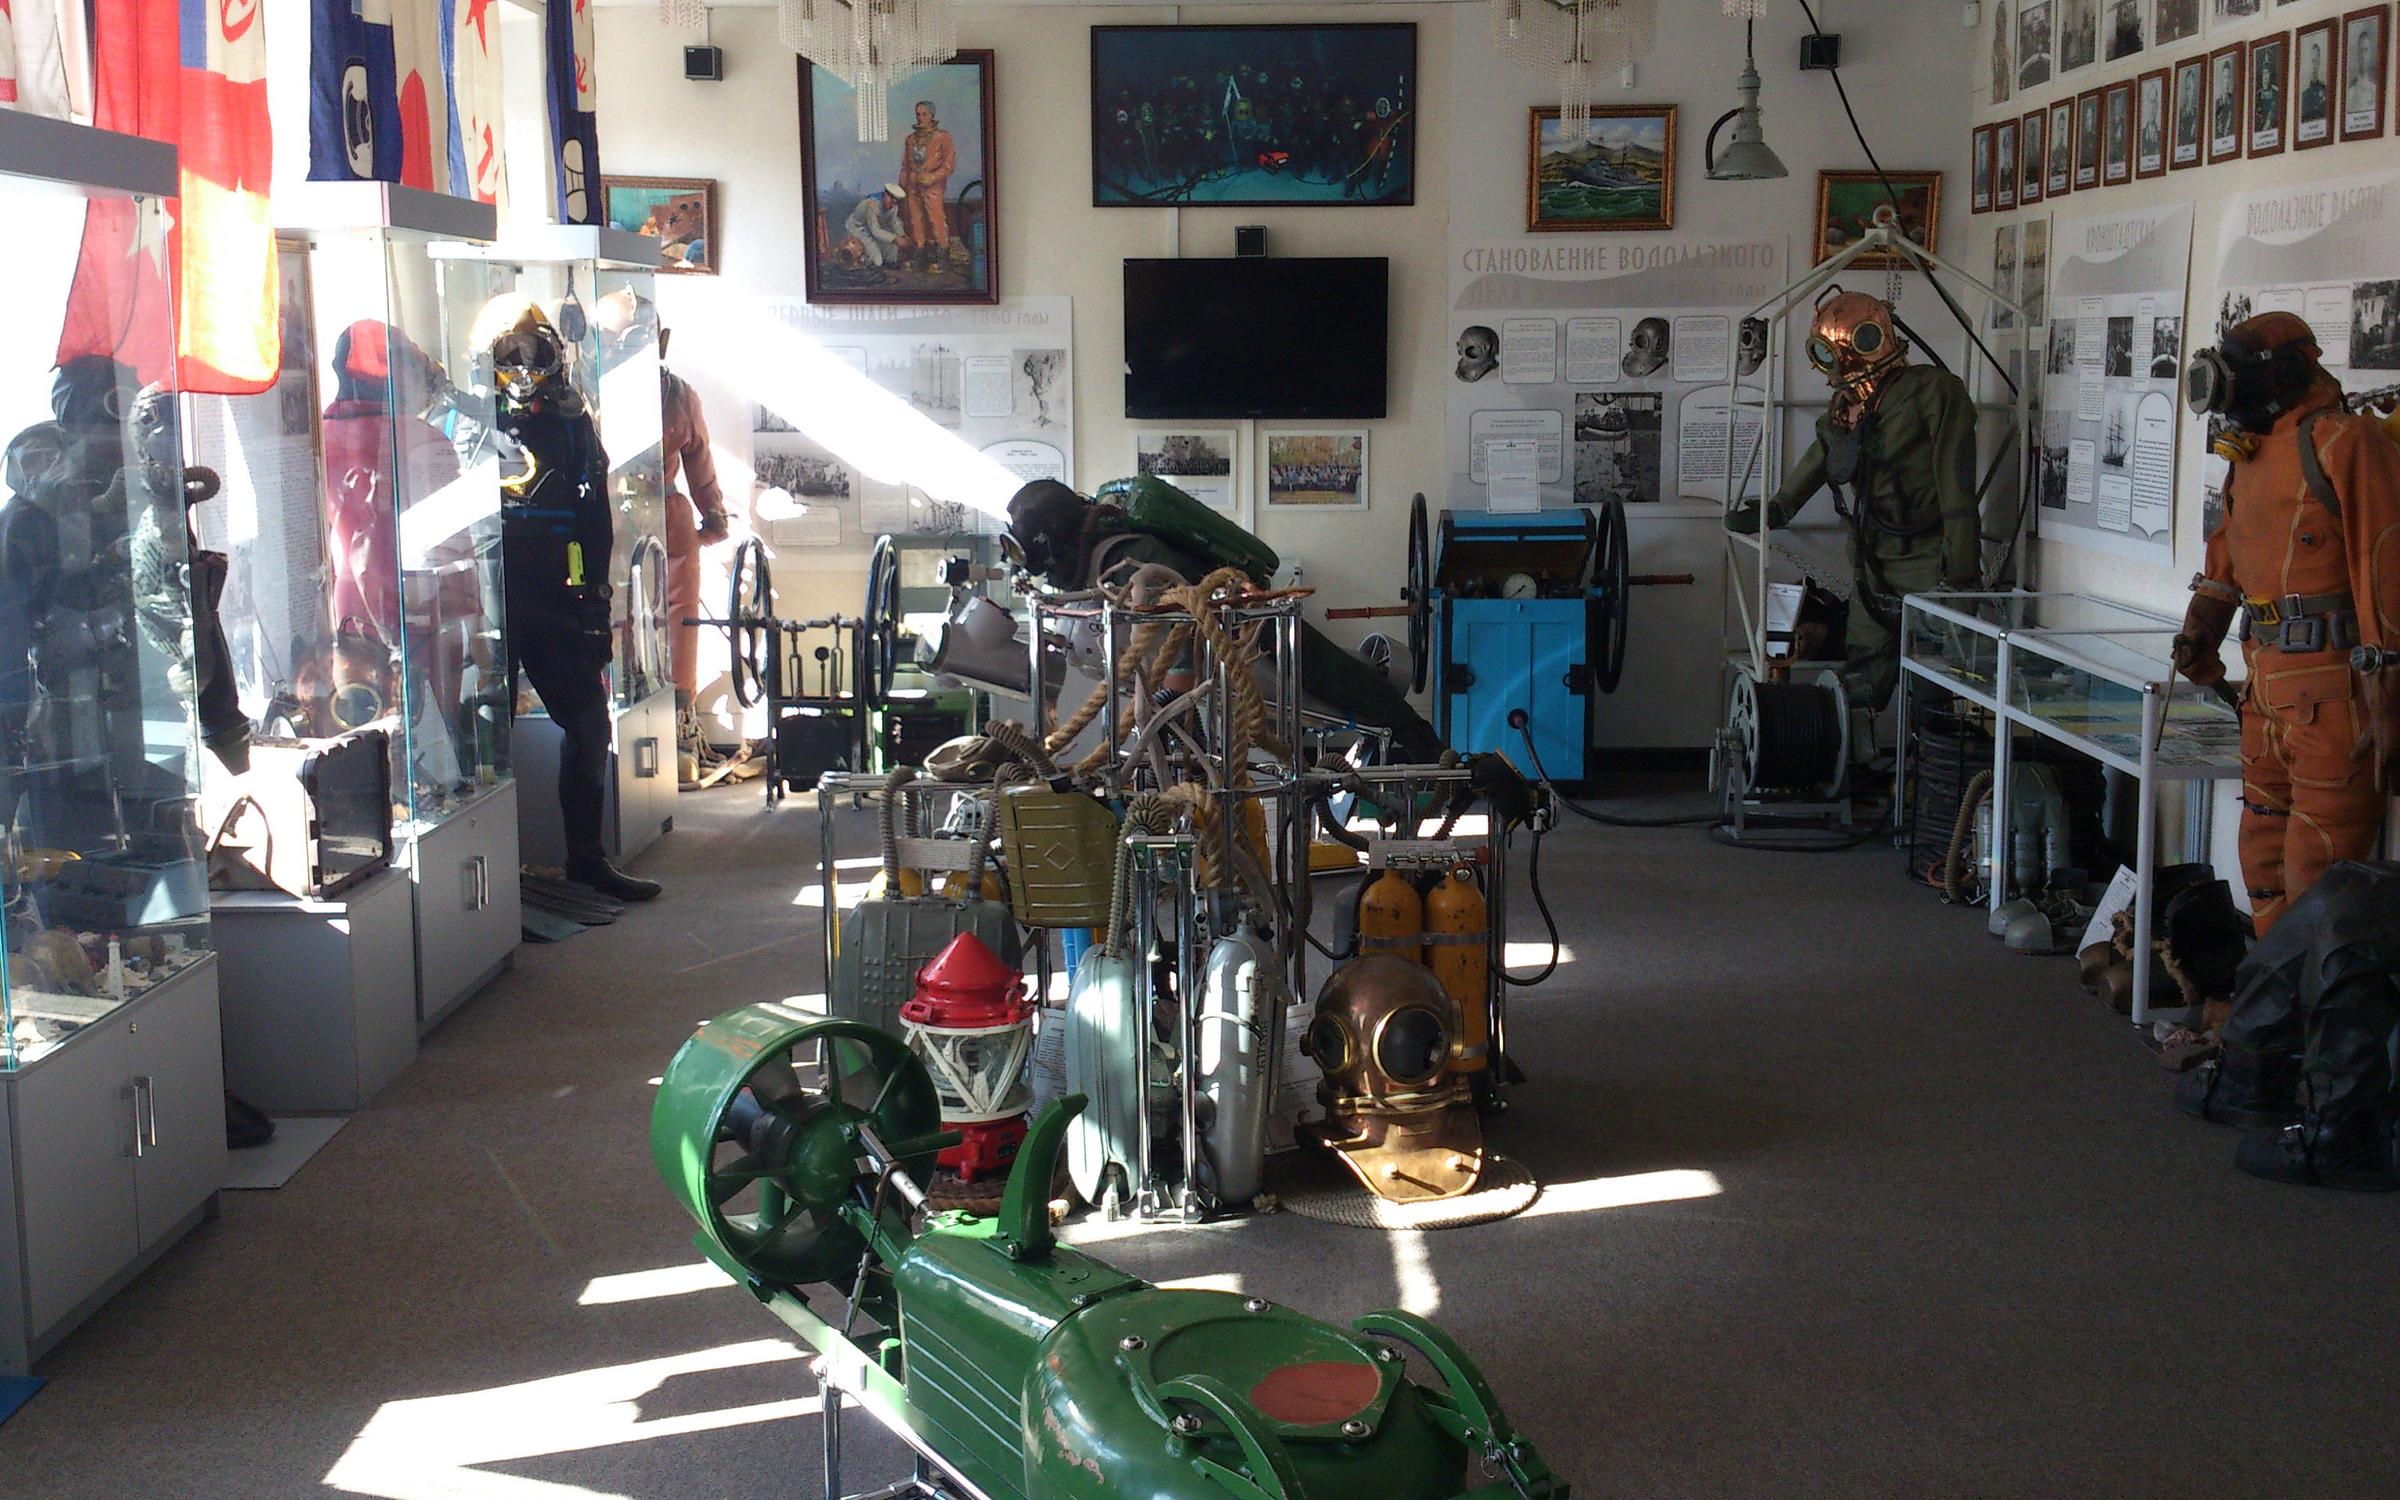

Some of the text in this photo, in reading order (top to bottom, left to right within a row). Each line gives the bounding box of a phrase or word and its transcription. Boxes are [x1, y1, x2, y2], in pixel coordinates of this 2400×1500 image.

[1462, 243, 1774, 272] СТАНОВЛЕНИЕ ВОДОЛАЗНОГО
[1016, 312, 1050, 326] годы
